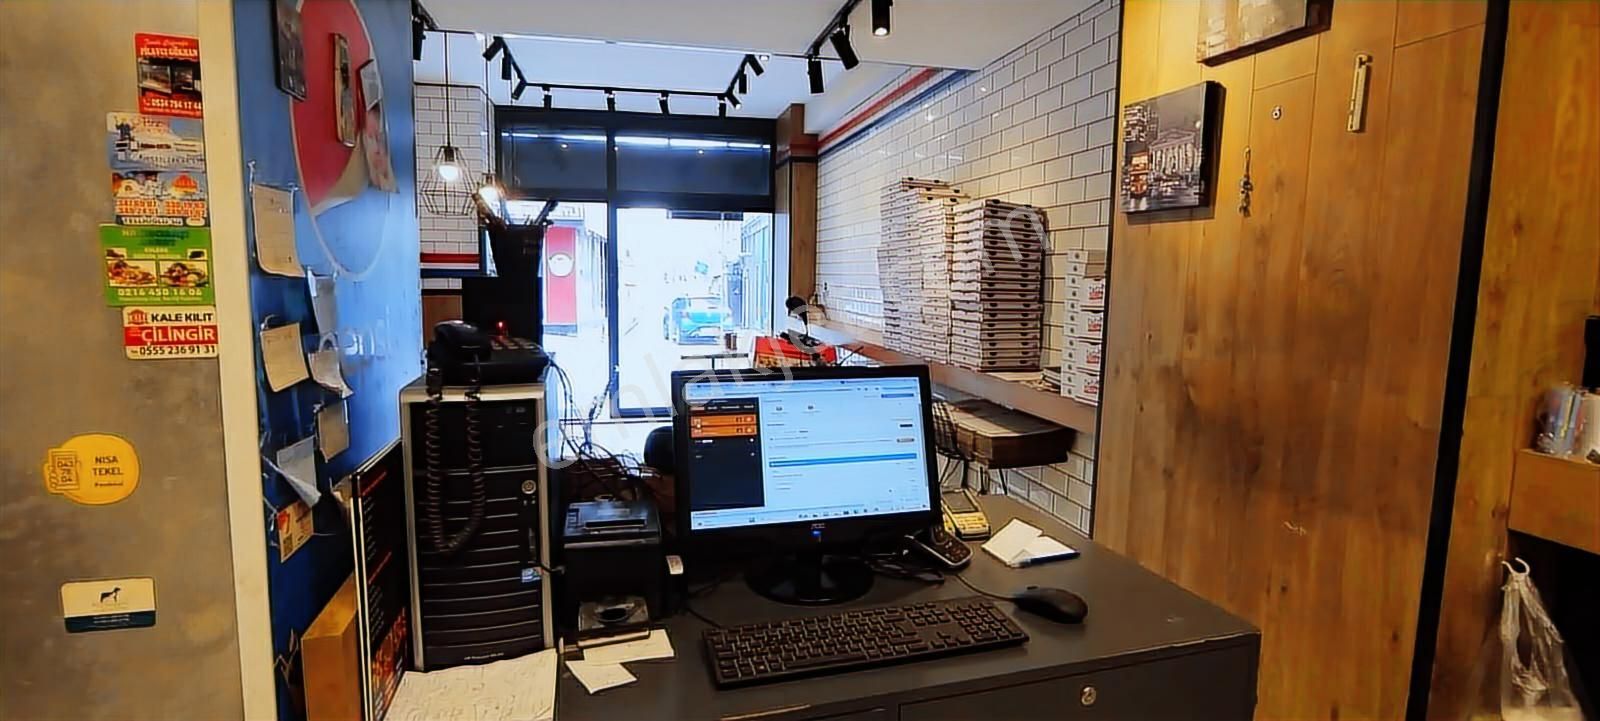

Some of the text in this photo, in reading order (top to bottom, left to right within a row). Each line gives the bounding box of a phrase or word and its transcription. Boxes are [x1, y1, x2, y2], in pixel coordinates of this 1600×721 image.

[151, 313, 183, 322] KALE
[142, 325, 216, 345] ÇİLİNGİR
[139, 345, 165, 355] 0555
[167, 345, 187, 355] 236
[188, 345, 200, 354] 91
[203, 344, 215, 354] 31
[92, 466, 124, 476] TEKEL
